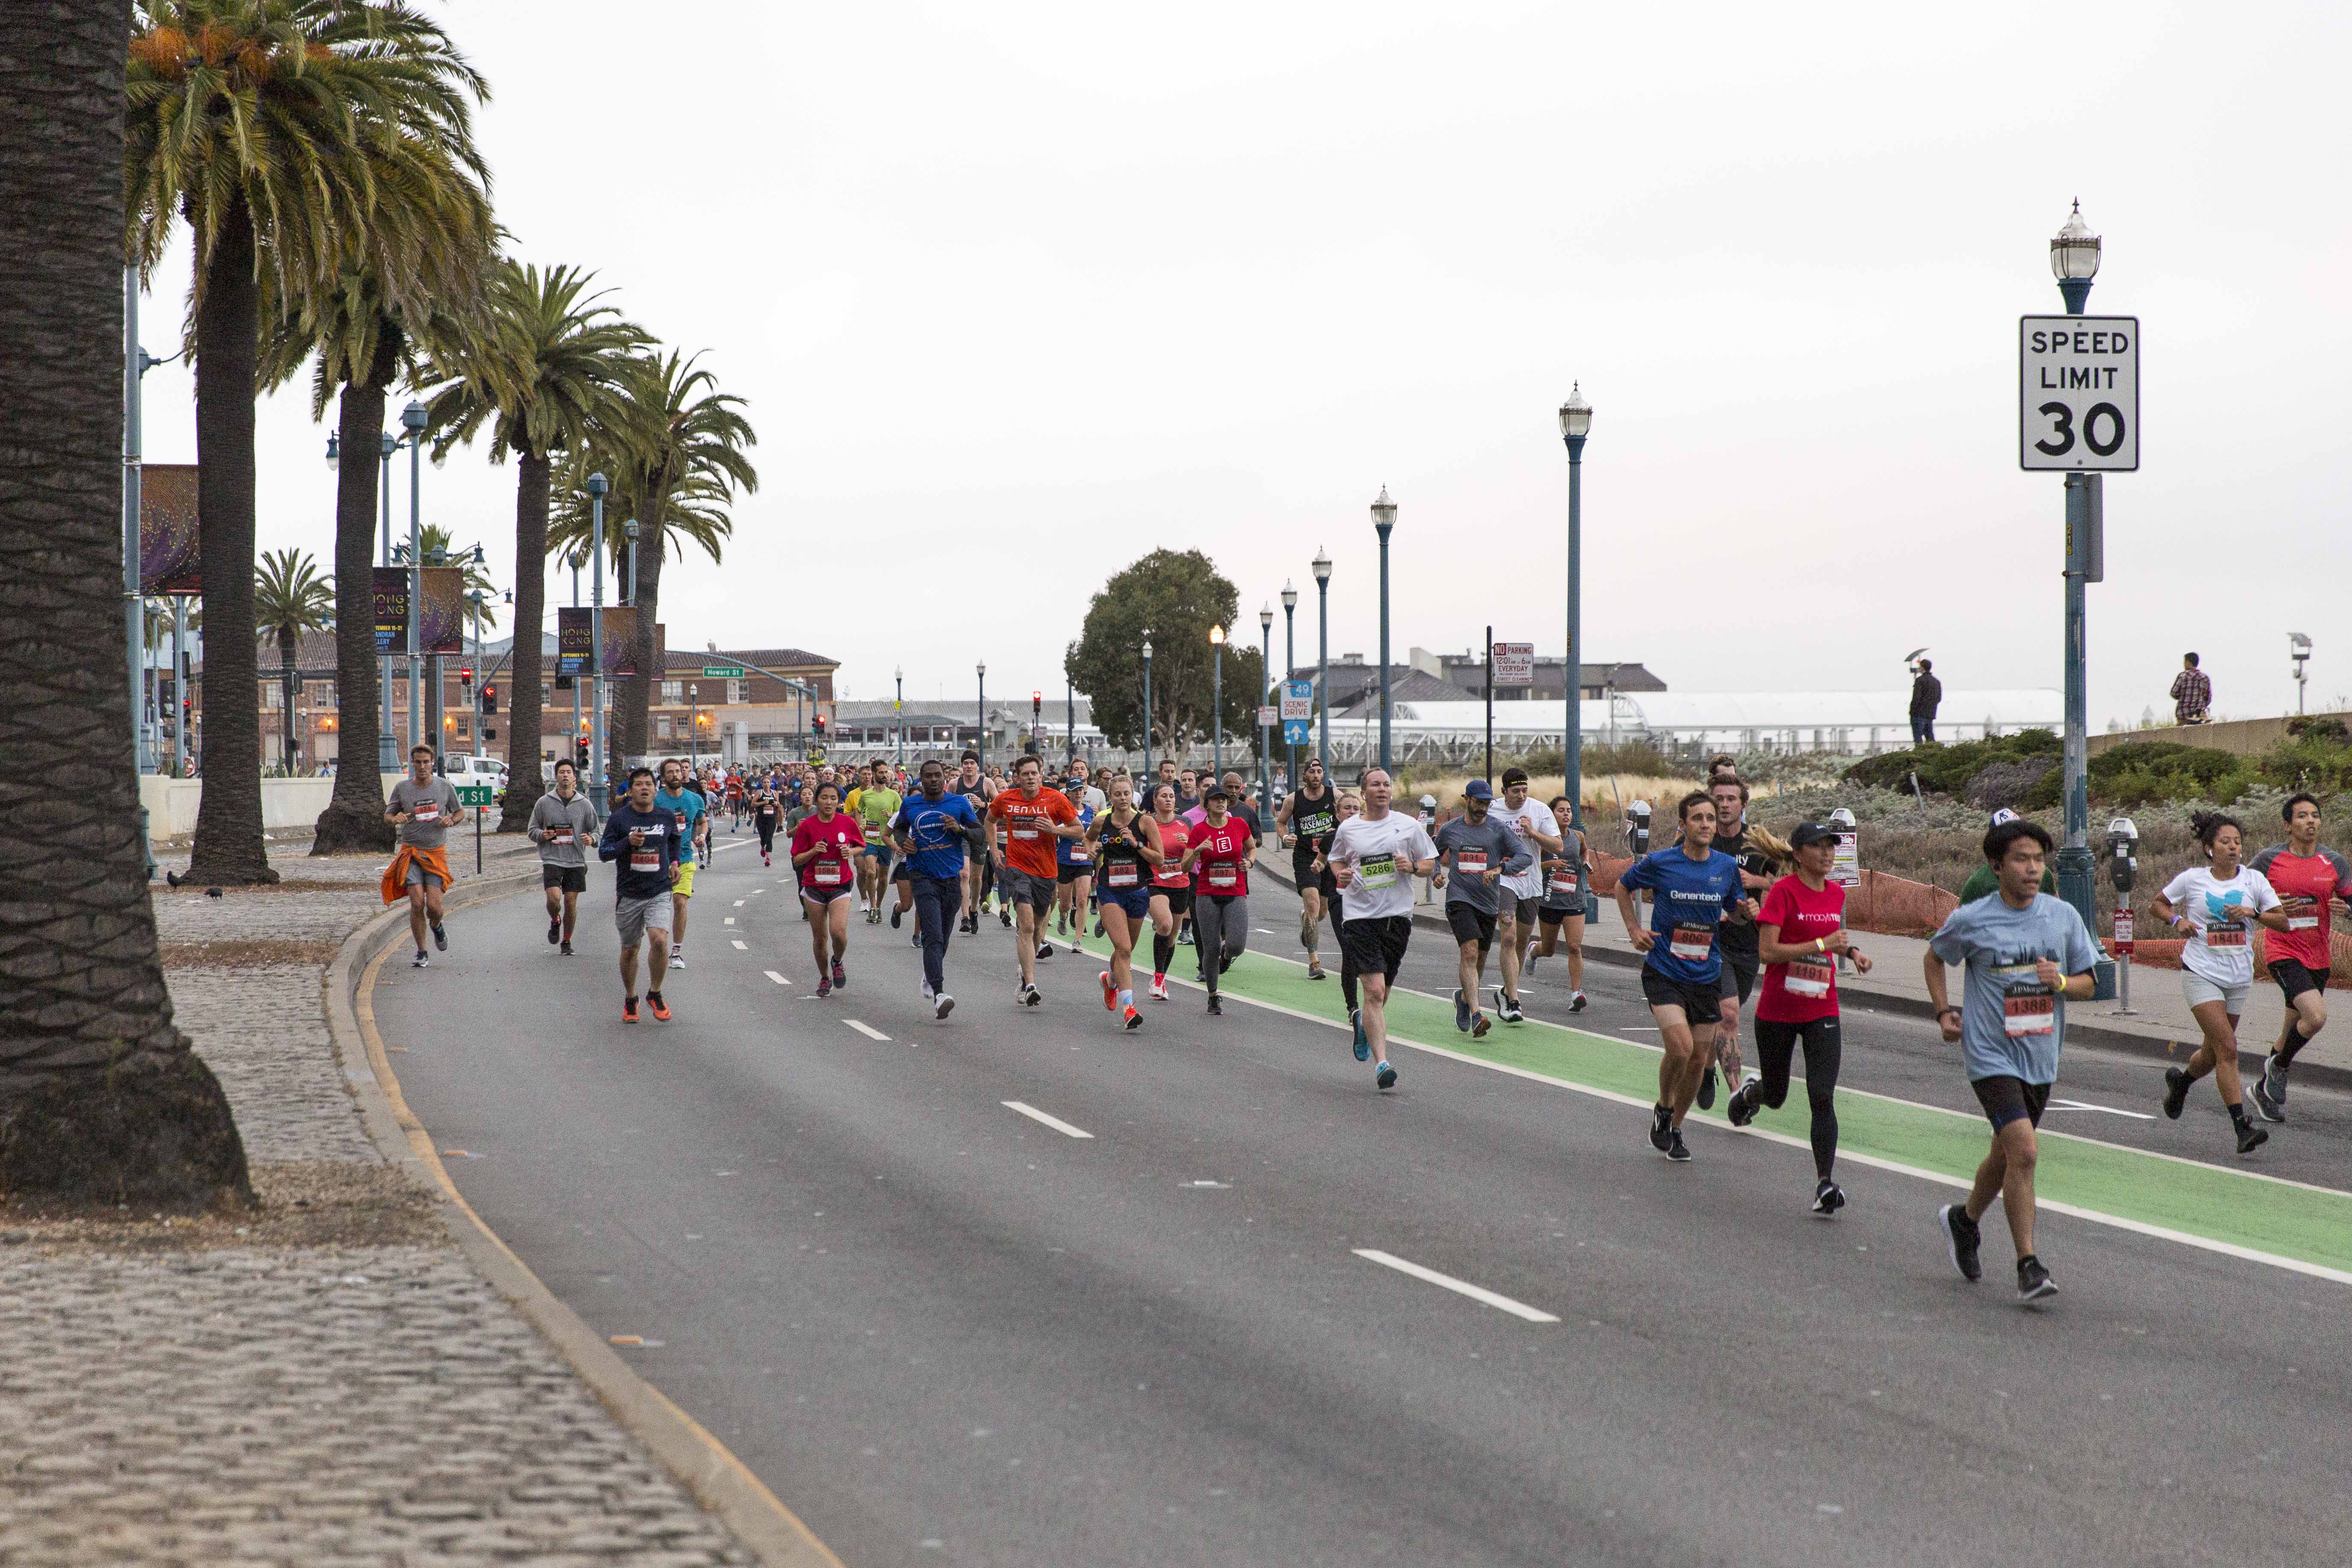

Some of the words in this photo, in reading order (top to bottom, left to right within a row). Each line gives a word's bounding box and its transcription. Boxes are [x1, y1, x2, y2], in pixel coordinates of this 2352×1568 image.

[2031, 332, 2128, 354] SPEED
[2041, 367, 2118, 389] LIMIT
[2034, 401, 2126, 456] 30
[377, 606, 404, 615] ONG
[1495, 644, 1505, 654] NO
[1296, 684, 1309, 693] 49
[471, 791, 484, 802] St
[1299, 814, 1317, 822] SPORTS
[1300, 815, 1333, 830] BASEMENT
[1102, 834, 1128, 846] Goog
[1366, 864, 1390, 876] 5286
[1560, 873, 1571, 883] 371
[1544, 867, 1557, 902] nywhere
[1670, 890, 1721, 901] Genentech
[1682, 922, 1710, 930] J.P.Morgan
[2213, 933, 2239, 945] 1841
[2012, 985, 2049, 994] J.P.Morgan
[2013, 999, 2046, 1013] 1388
